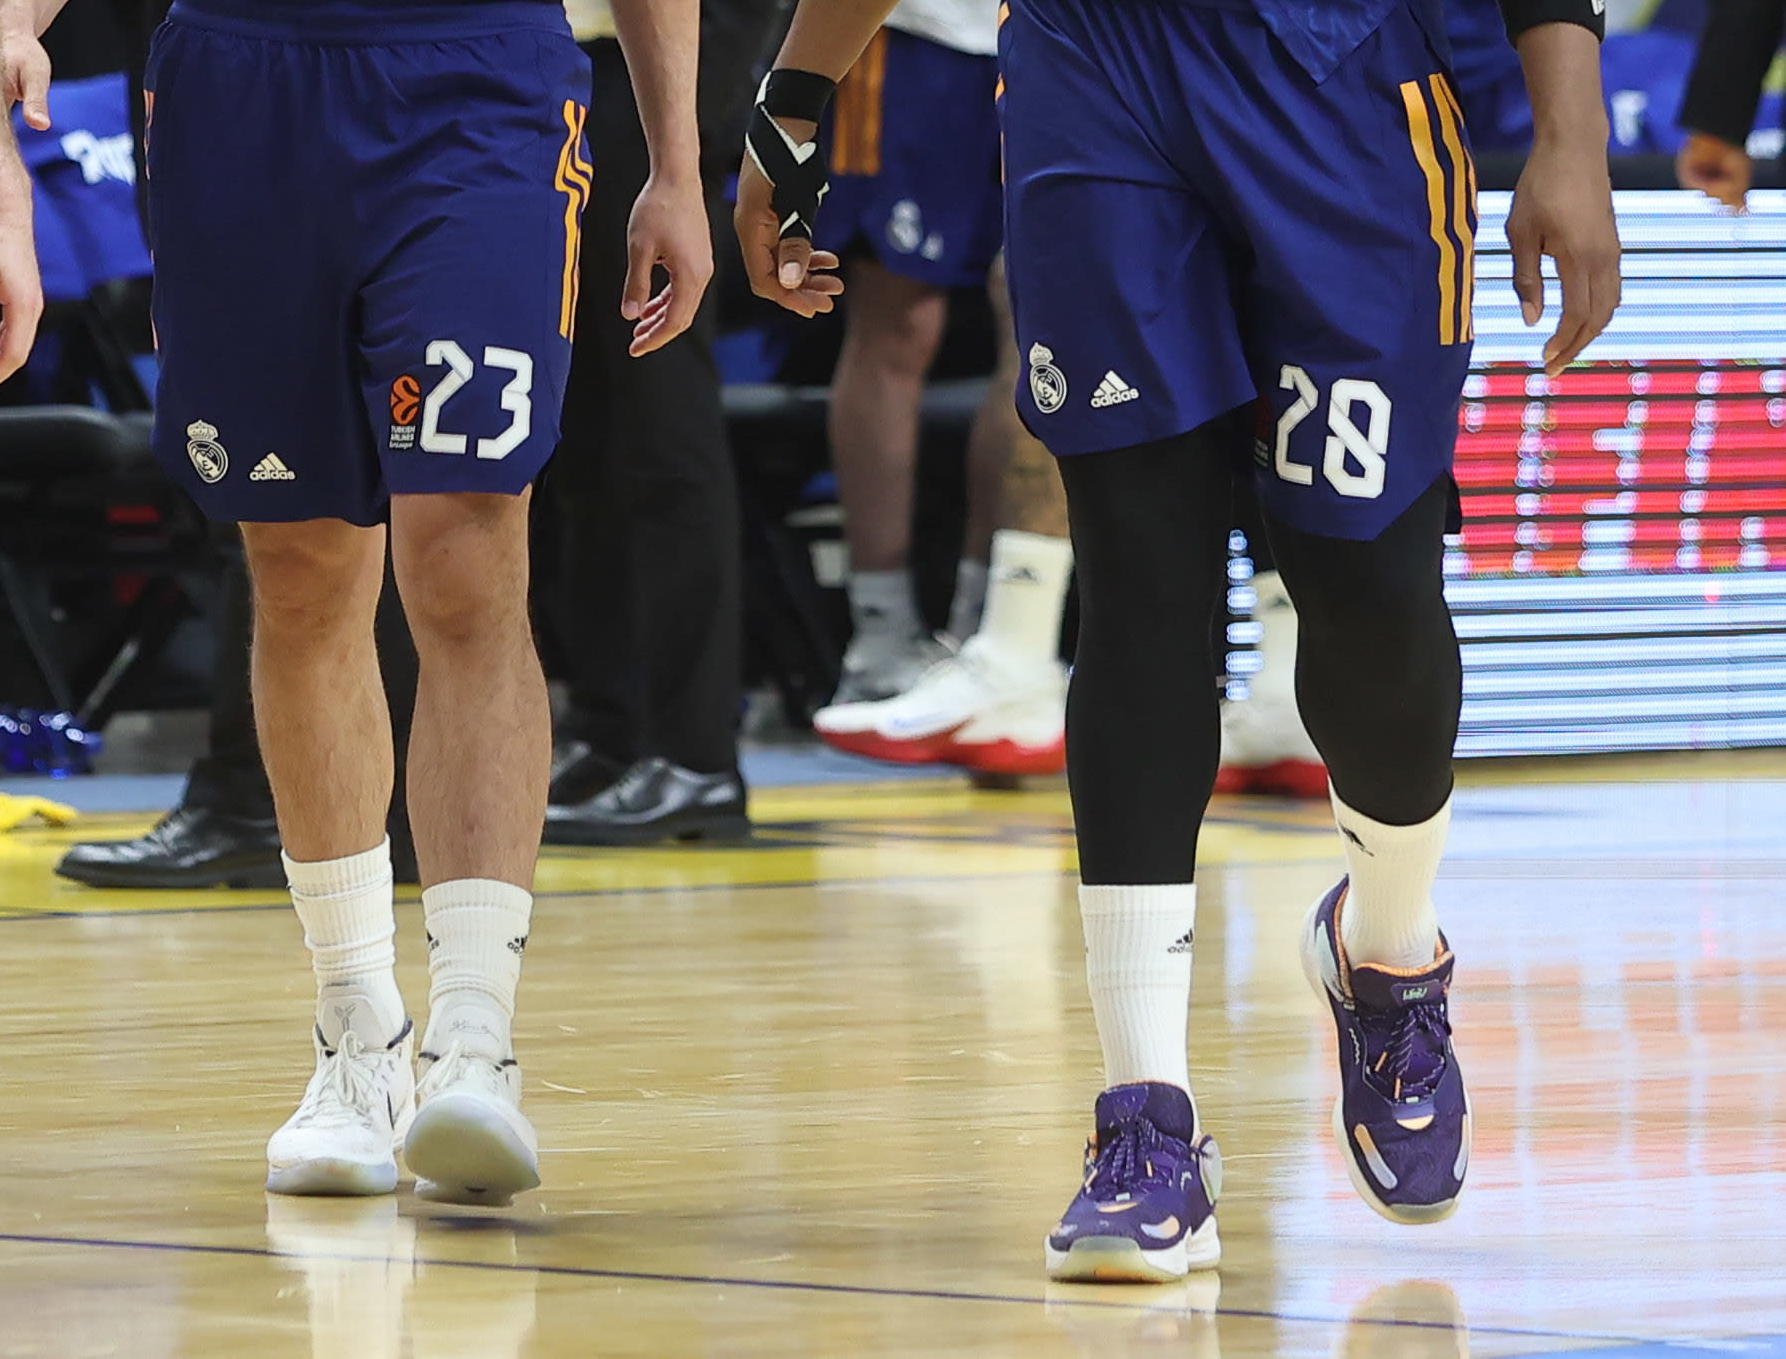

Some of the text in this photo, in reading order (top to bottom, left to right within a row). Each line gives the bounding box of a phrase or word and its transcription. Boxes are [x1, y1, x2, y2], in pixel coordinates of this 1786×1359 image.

[419, 340, 534, 460] 23
[1090, 387, 1140, 409] adidas
[1275, 364, 1392, 499] 28
[249, 468, 297, 481] adidas
